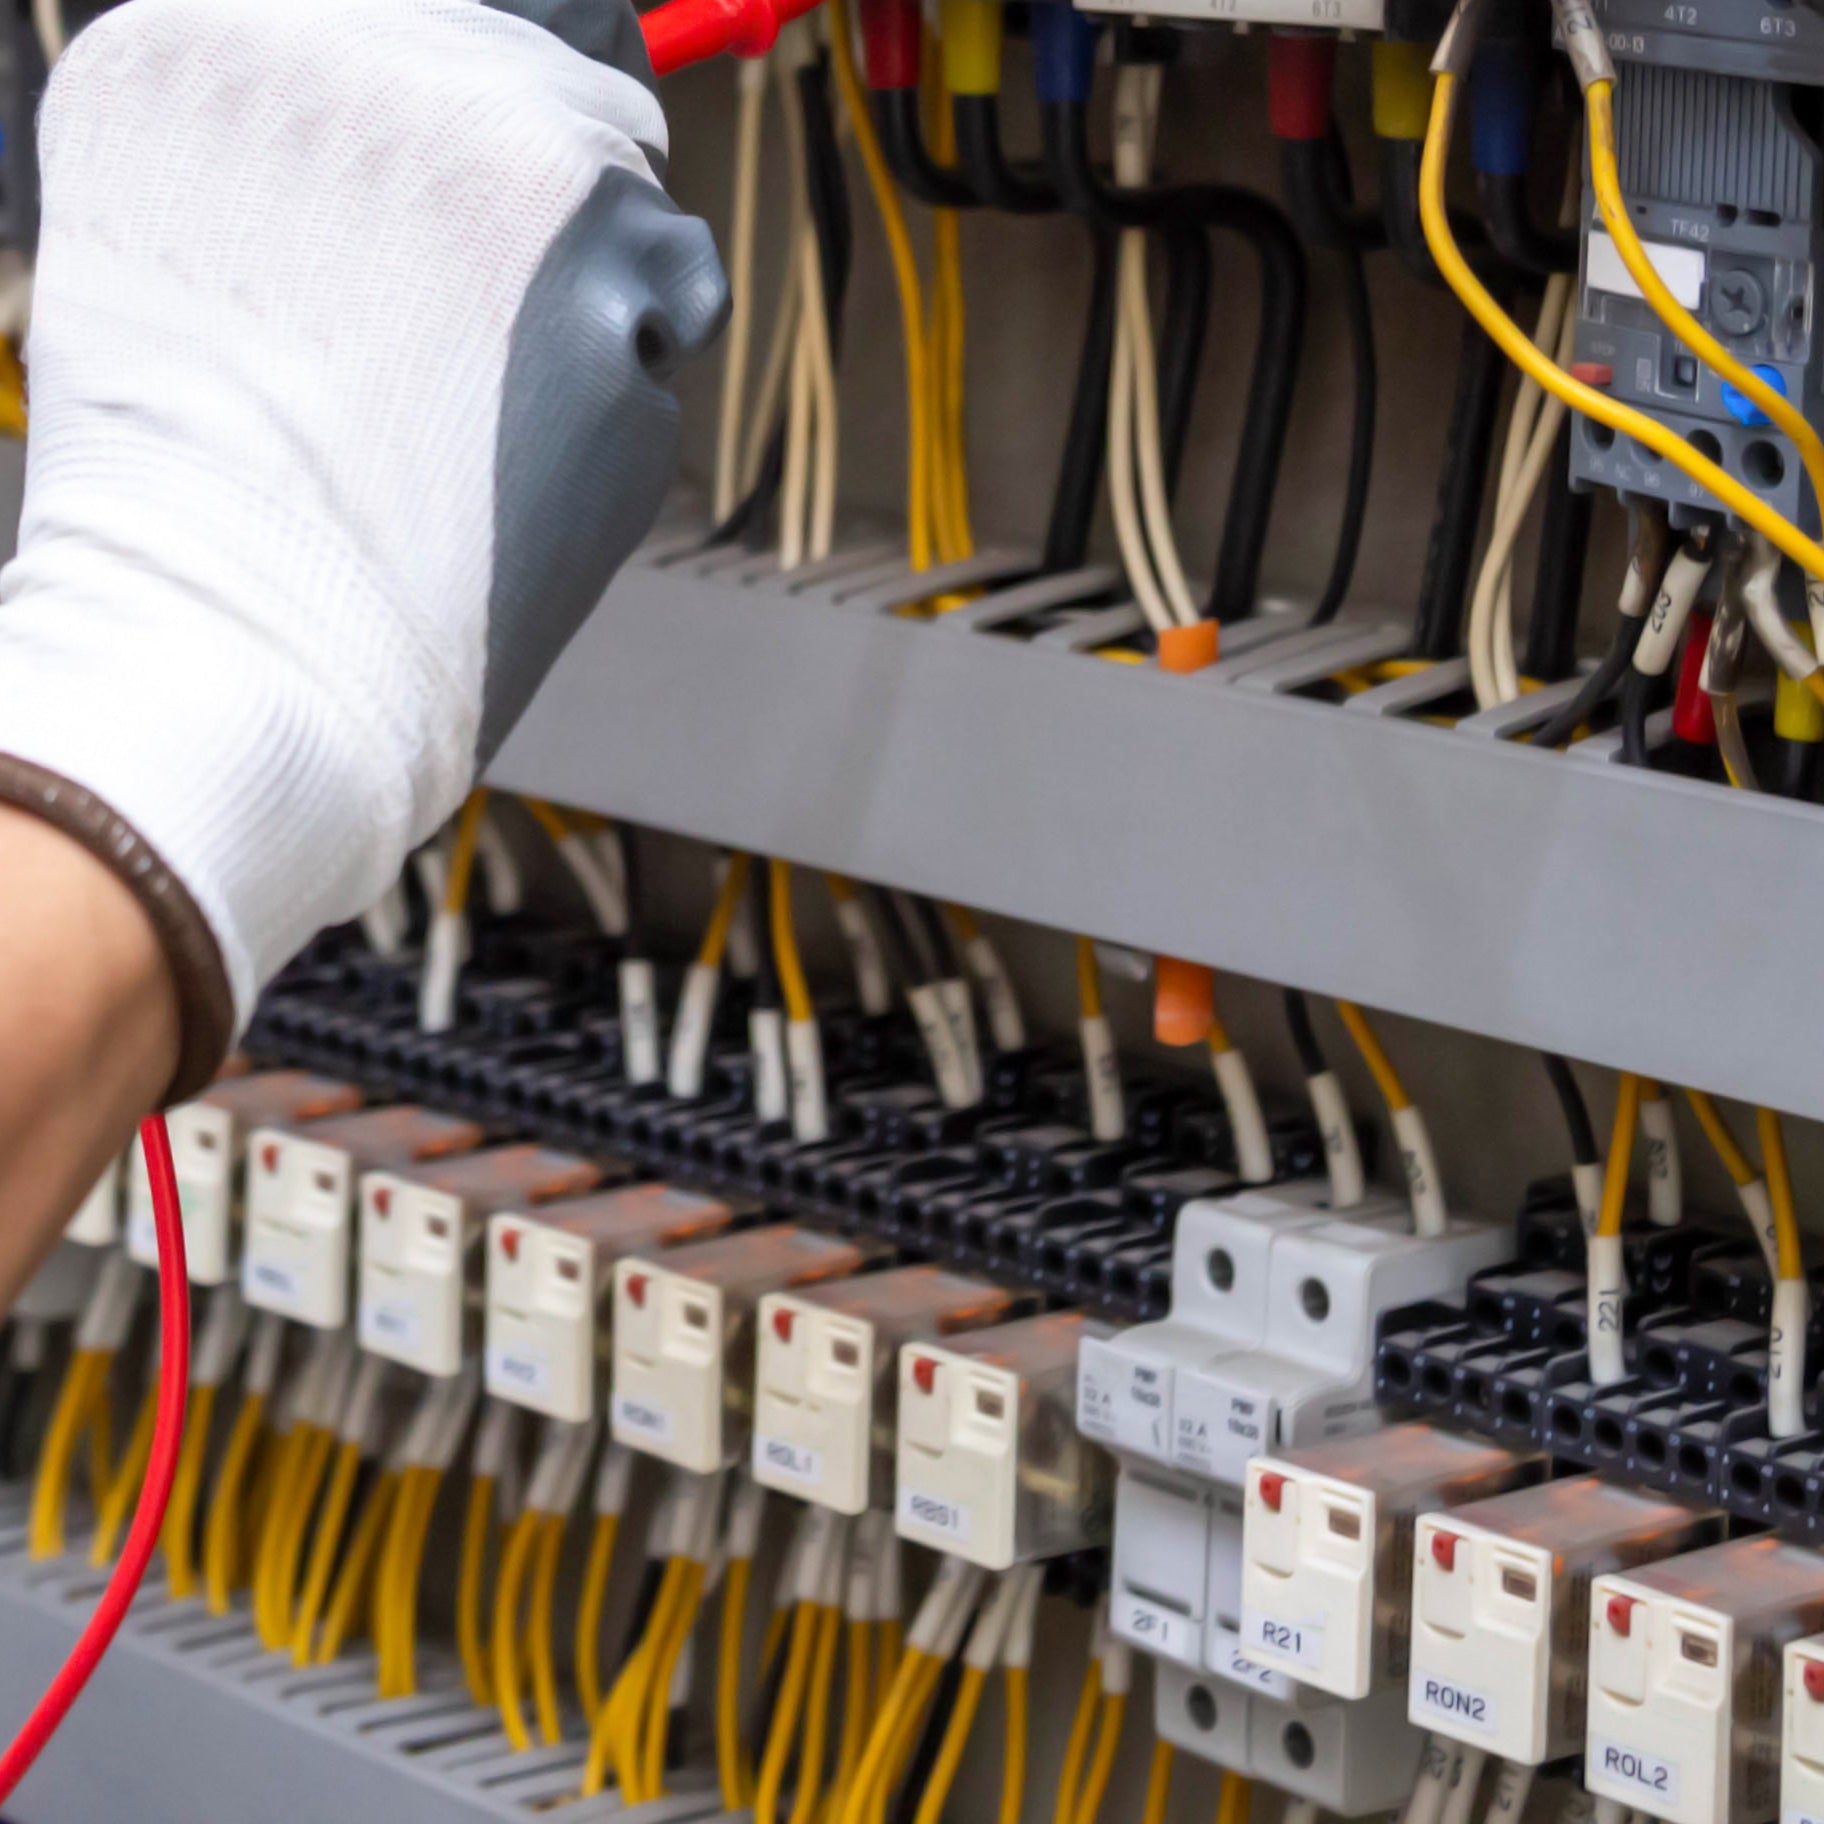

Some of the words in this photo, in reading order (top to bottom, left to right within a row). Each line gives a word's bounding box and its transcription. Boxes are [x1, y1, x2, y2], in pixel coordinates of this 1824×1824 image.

[1664, 5, 1698, 25] 4T2
[1760, 16, 1797, 38] 6T3
[1670, 218, 1711, 243] TF42
[1598, 1287, 1621, 1333] 221
[1262, 1620, 1302, 1653] R21
[1425, 1680, 1486, 1721] RON2
[1604, 1746, 1668, 1791] ROL2
